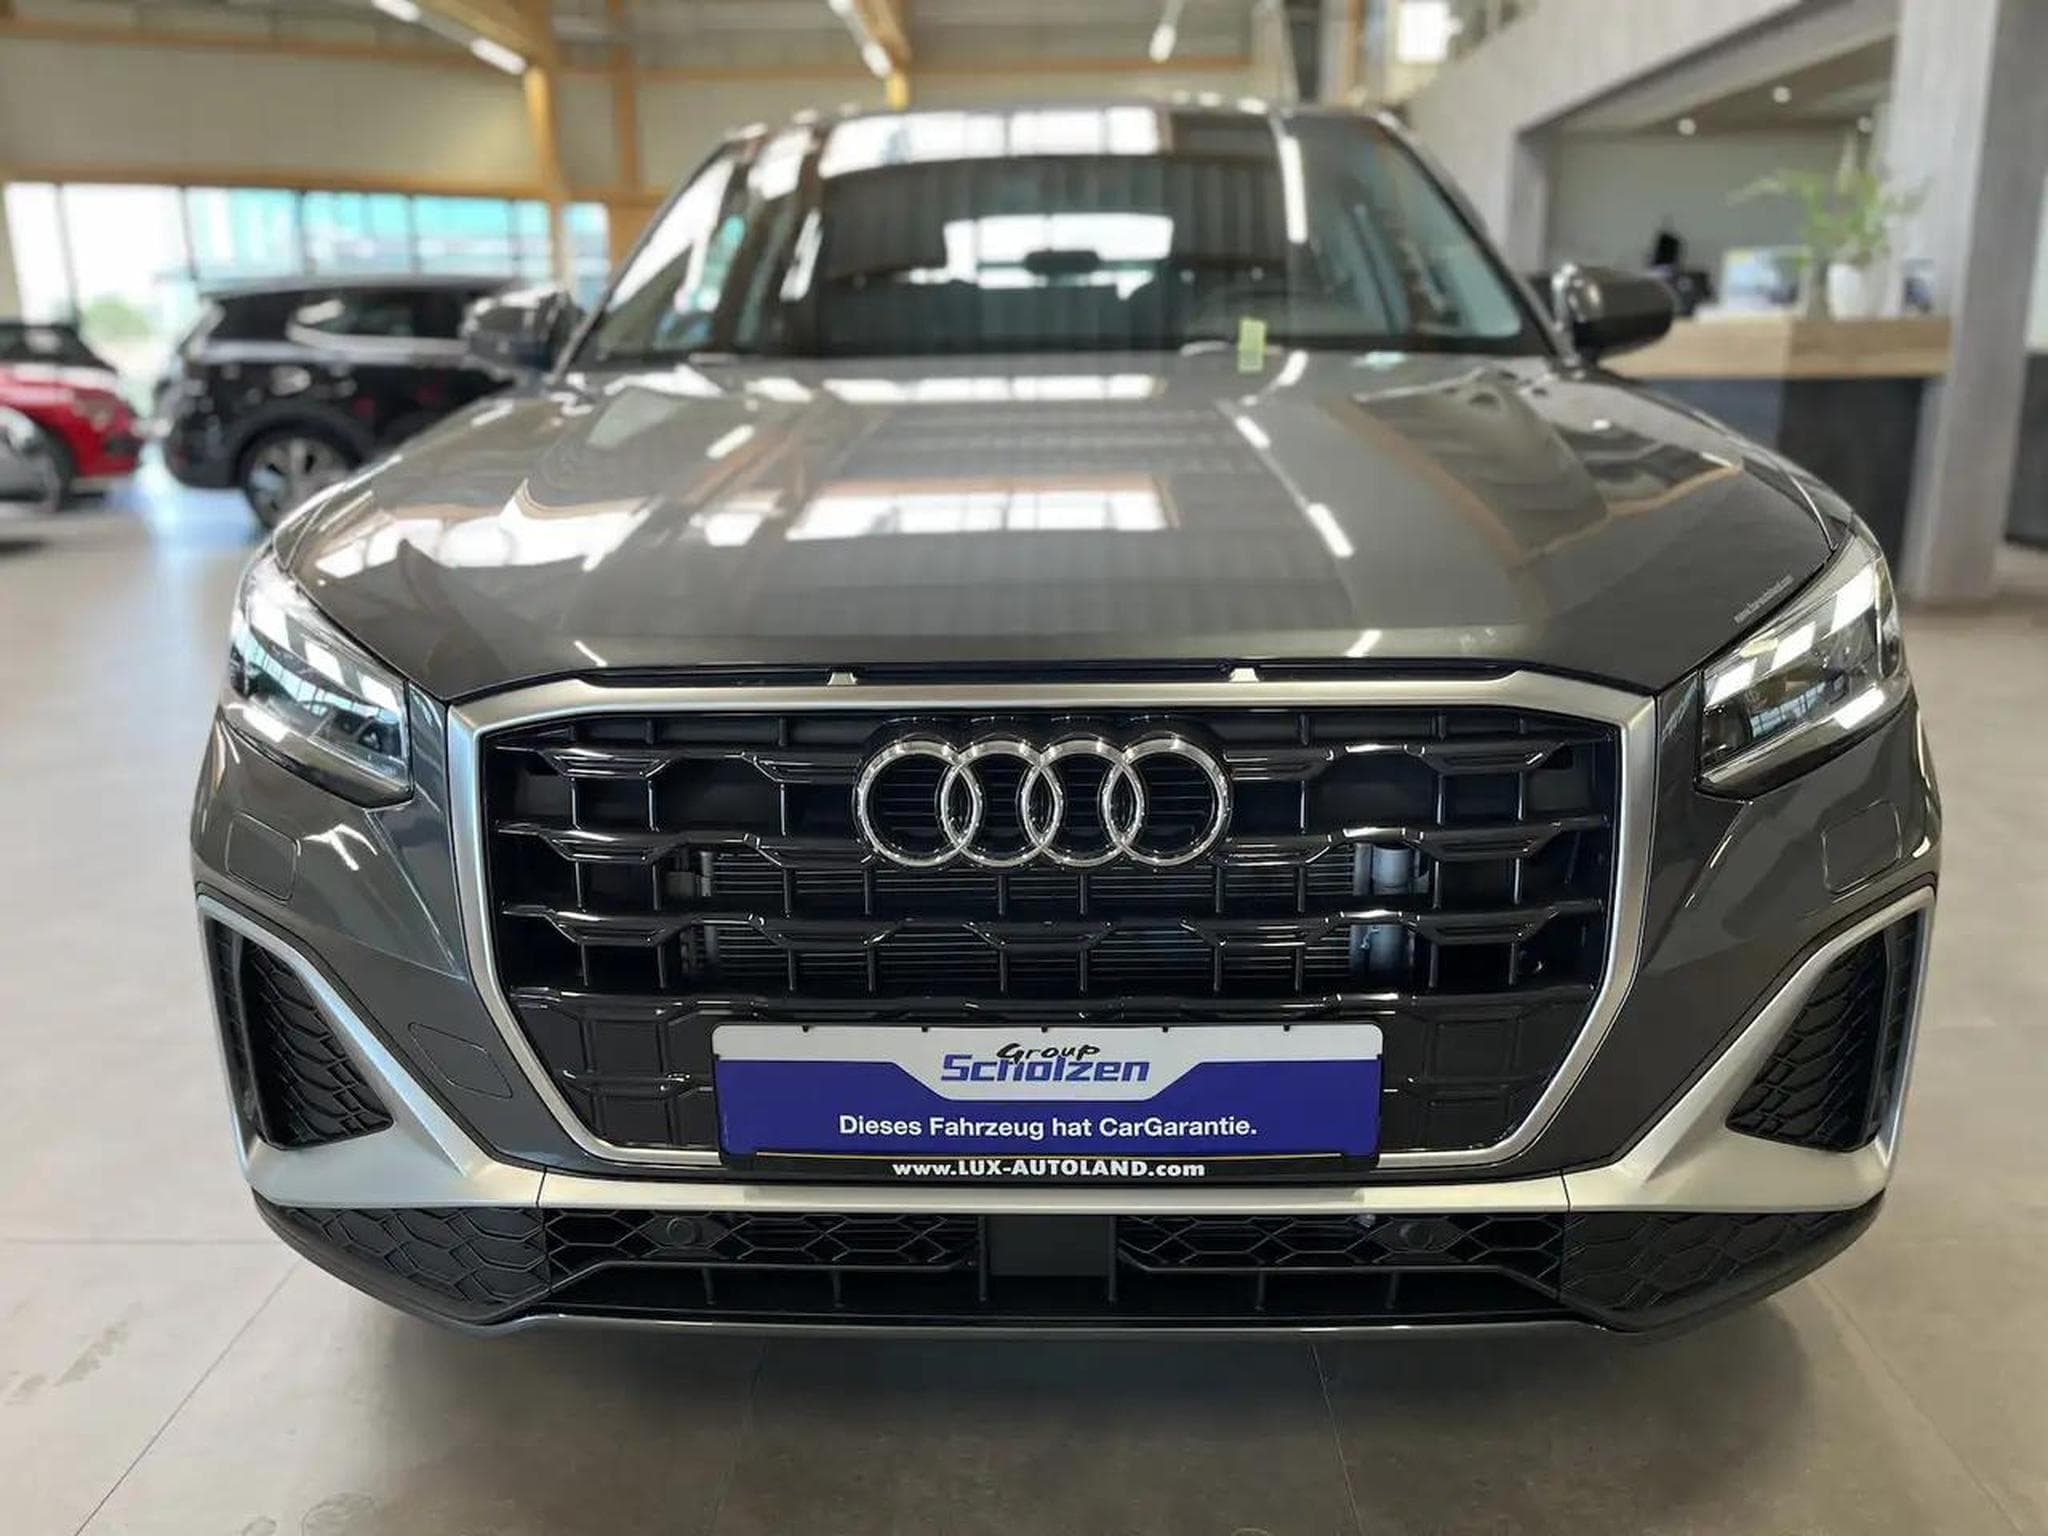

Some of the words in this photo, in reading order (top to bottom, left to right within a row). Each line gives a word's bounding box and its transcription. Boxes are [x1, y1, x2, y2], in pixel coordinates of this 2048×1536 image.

[996, 1042, 1101, 1063] Group
[940, 1053, 1150, 1081] Scholzen
[839, 1115, 922, 1136] Dieses
[929, 1116, 1045, 1141] Fahrzeug
[1052, 1117, 1093, 1137] hat
[1099, 1115, 1257, 1137] CarGarantie.
[892, 1159, 1206, 1177] www.LUX-AUTOLAND.com
